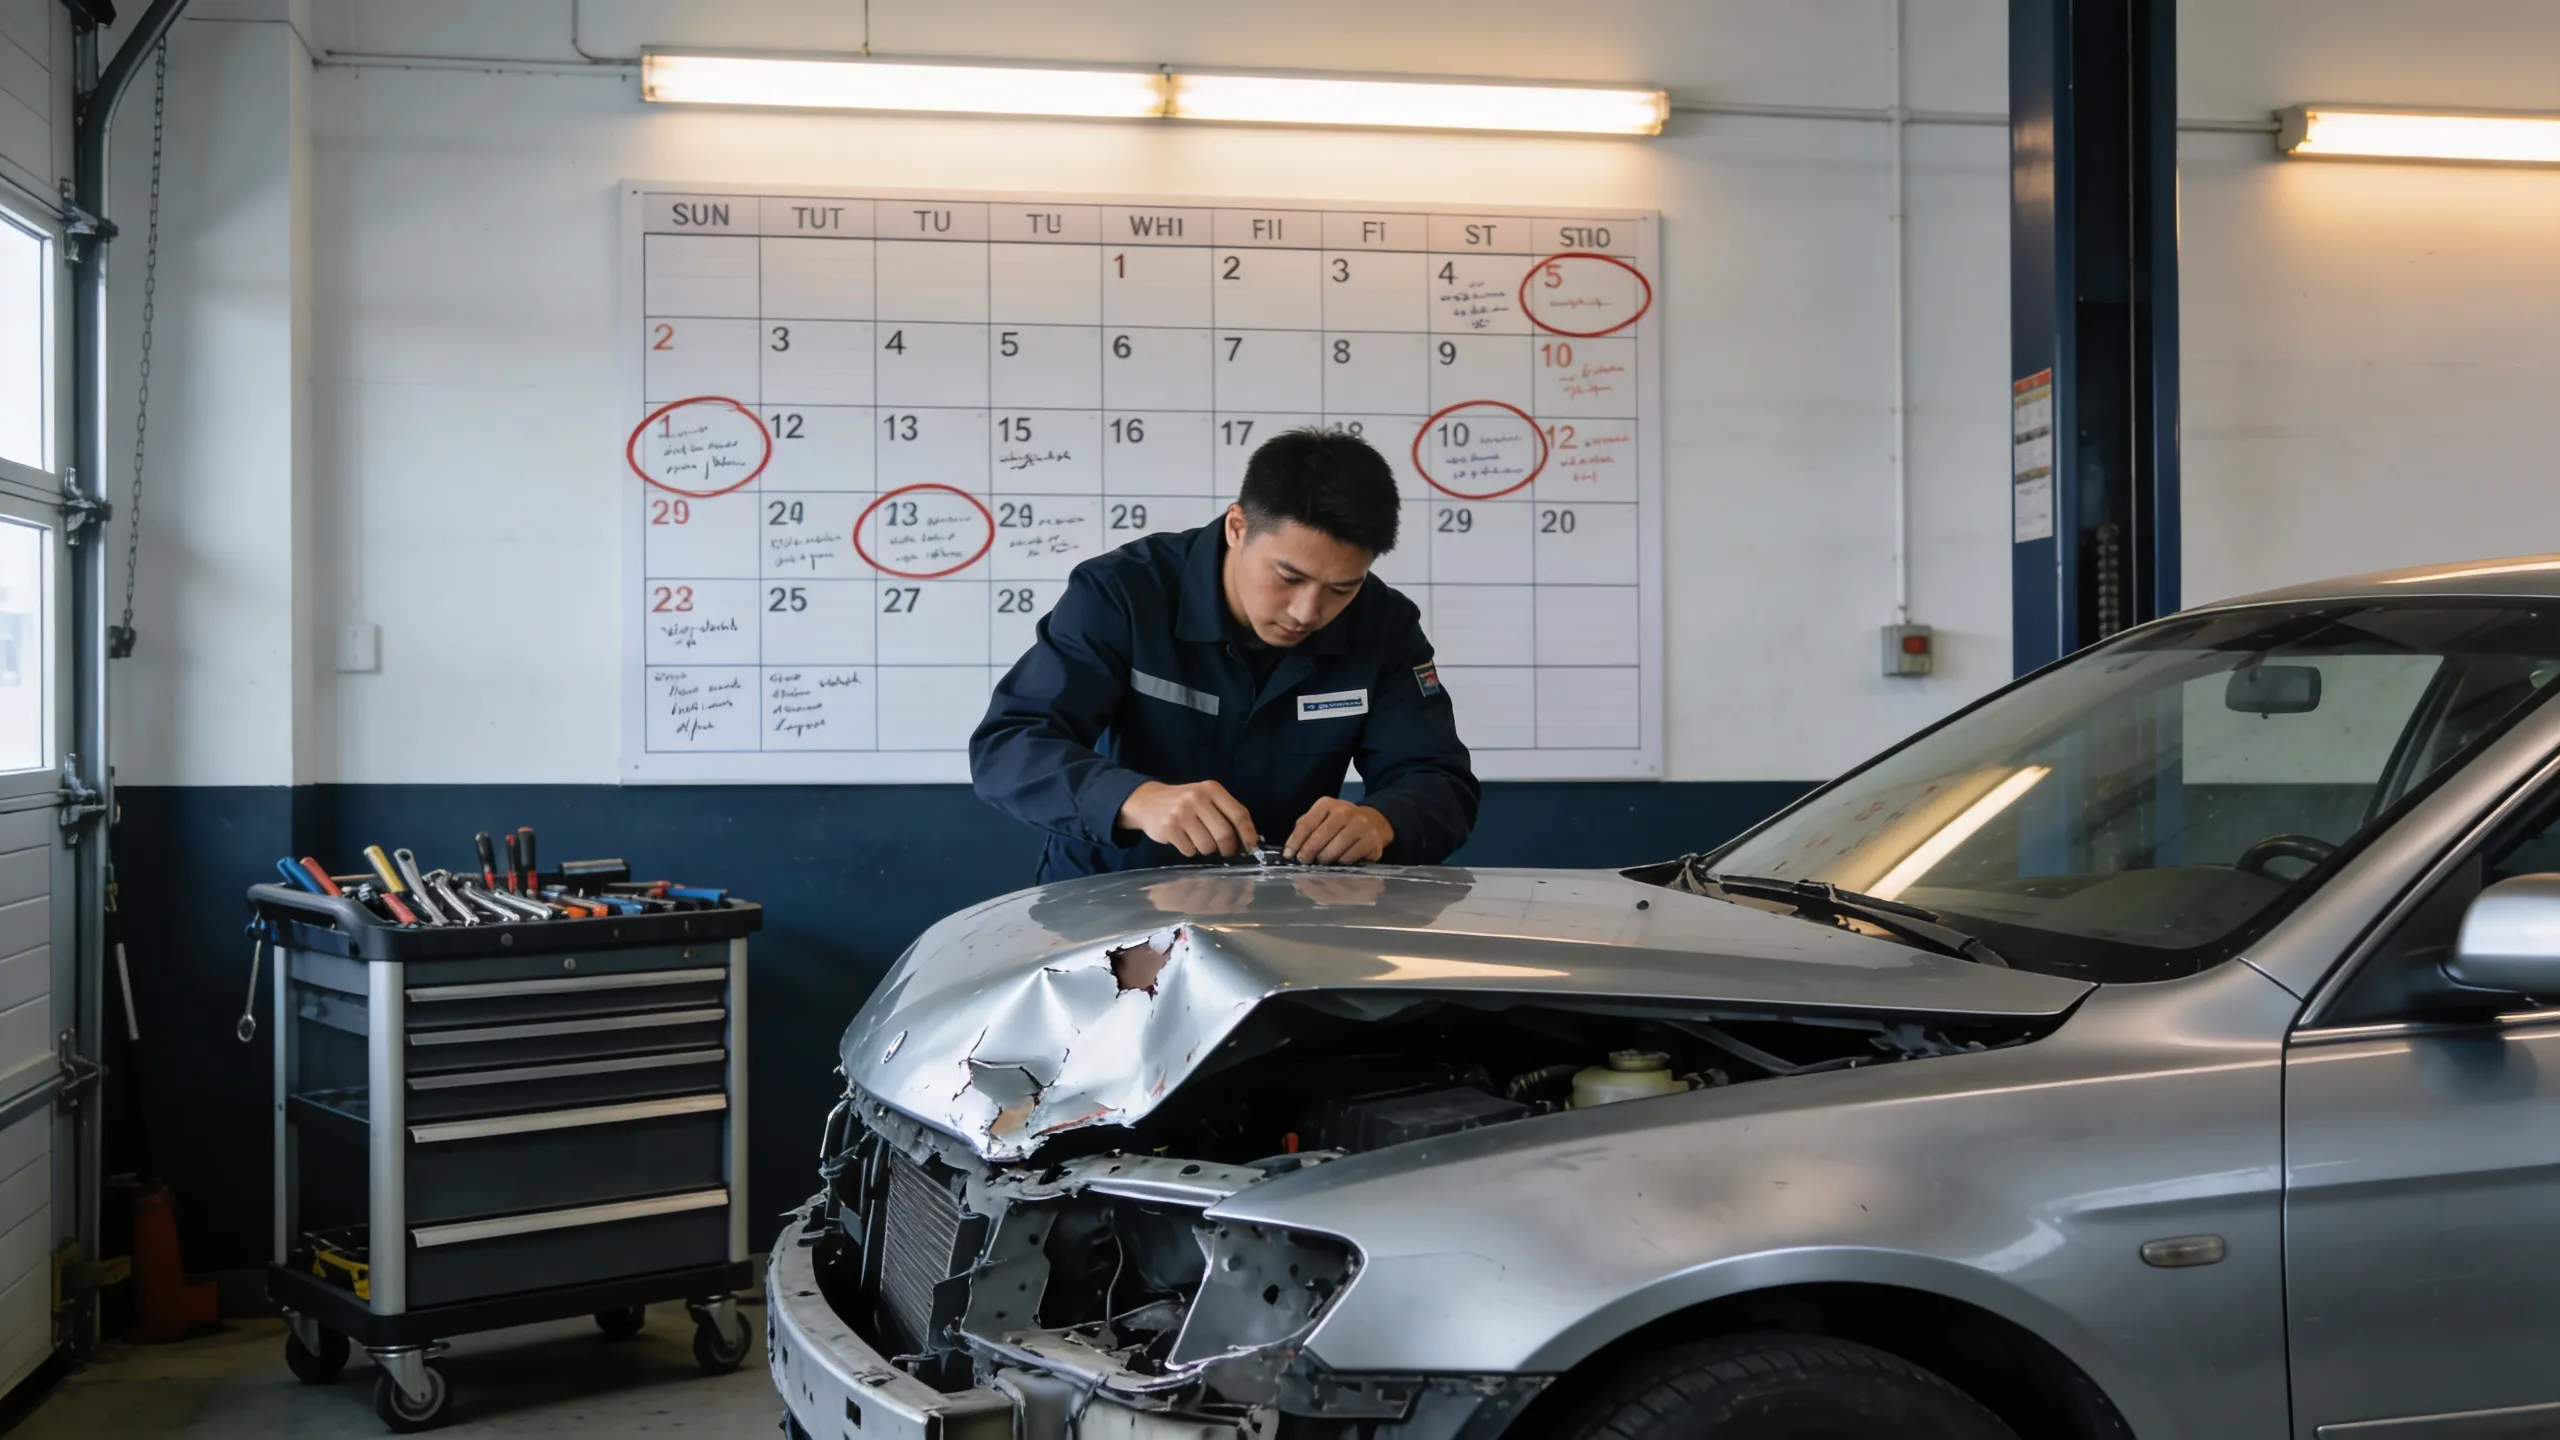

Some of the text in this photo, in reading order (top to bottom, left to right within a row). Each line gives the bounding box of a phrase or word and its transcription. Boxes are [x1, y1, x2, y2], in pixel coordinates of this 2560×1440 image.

[672, 203, 729, 226] SUN
[791, 207, 845, 230] TUT
[913, 211, 951, 232] TU
[1026, 214, 1061, 234] TU
[1129, 215, 1183, 237] WHI
[1465, 224, 1496, 246] ST
[1113, 254, 1562, 289] 1 2 3 4 5
[653, 324, 1573, 368] 2 3 4 5 6 7 8 9 10
[769, 414, 804, 439] 12
[884, 414, 918, 441] 13
[998, 417, 1032, 442] 15
[1110, 418, 1144, 443] 16
[1221, 420, 1254, 446] 17
[1437, 422, 1470, 447] 10
[1545, 425, 1577, 449] 12
[1438, 508, 1473, 533] 29
[1541, 510, 1576, 534] 20
[769, 587, 807, 612] 25
[883, 588, 920, 613] 27
[998, 589, 1034, 613] 28
